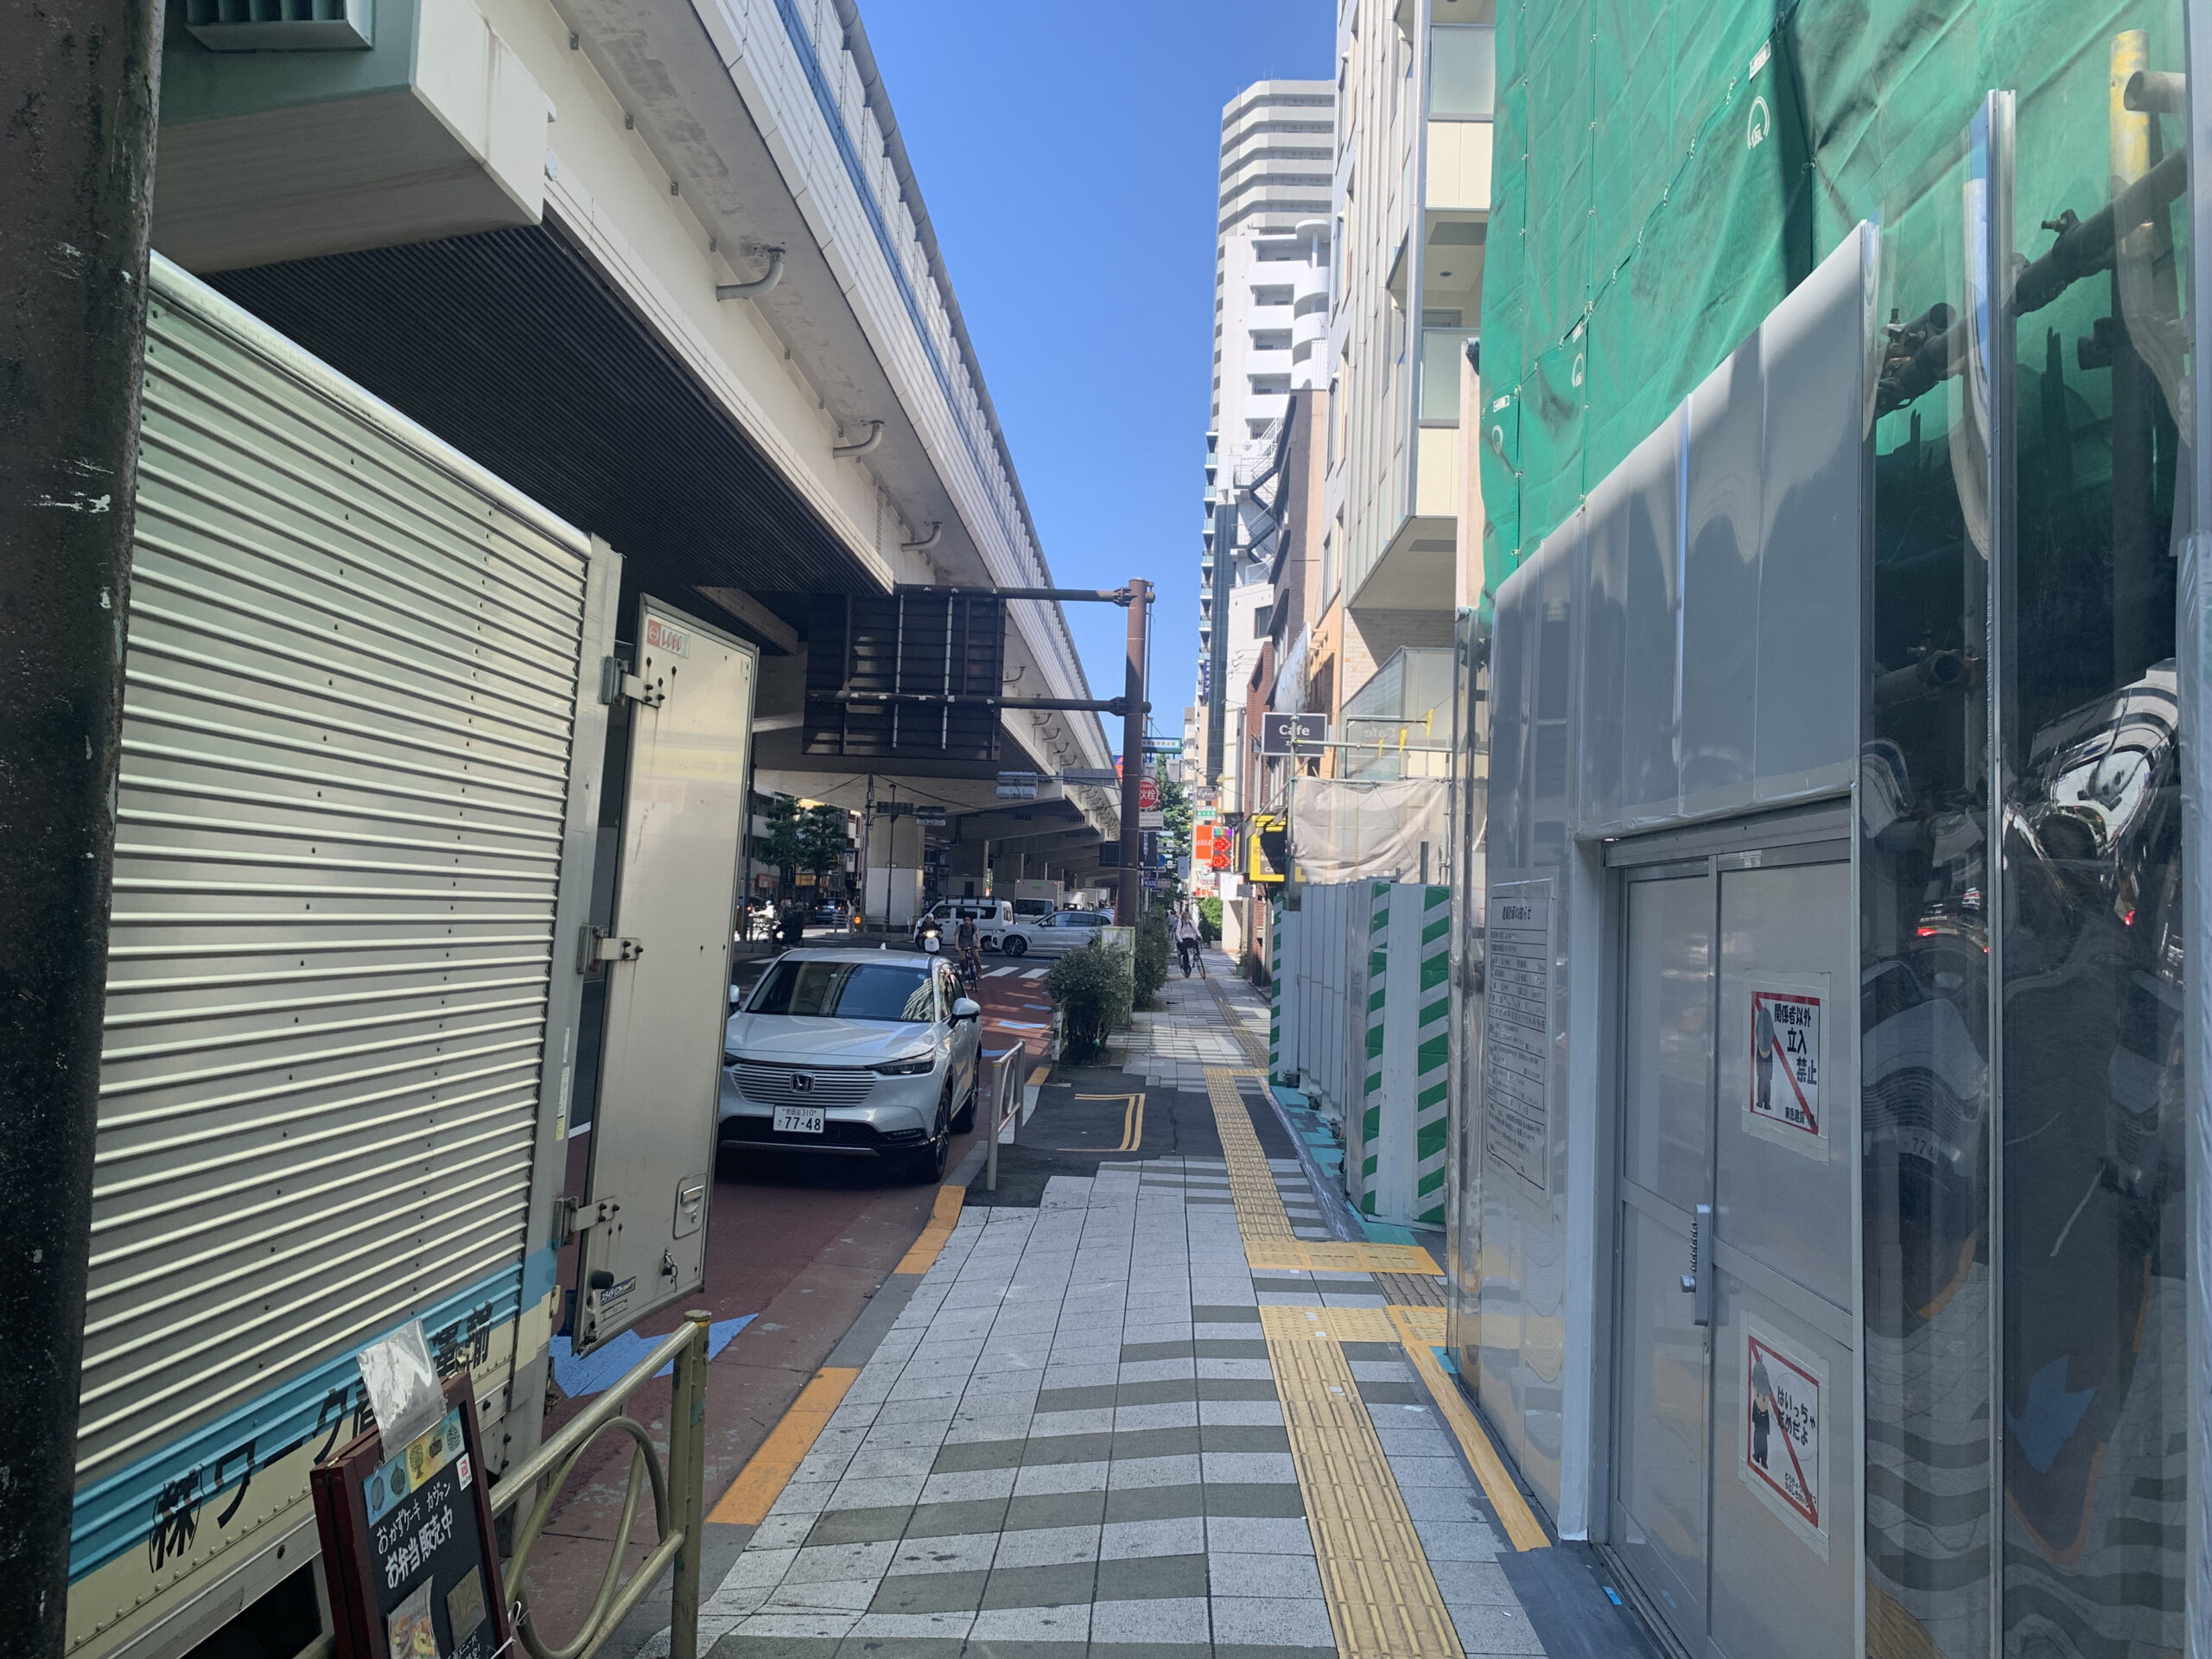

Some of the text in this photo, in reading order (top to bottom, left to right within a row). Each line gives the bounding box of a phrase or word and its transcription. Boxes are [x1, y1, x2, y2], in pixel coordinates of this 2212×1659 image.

[1279, 725, 1310, 735] Cafe
[1141, 789, 1155, 800] 火栓
[1774, 1003, 1811, 1027] 関係者以外
[1787, 1027, 1807, 1055] 立入
[1796, 1057, 1817, 1085] 禁止
[785, 1116, 821, 1131] 77-48
[1777, 1386, 1815, 1430] はいっちゃ
[377, 1498, 421, 1554] おかずケーキ
[385, 1504, 453, 1589] お弁当販売中
